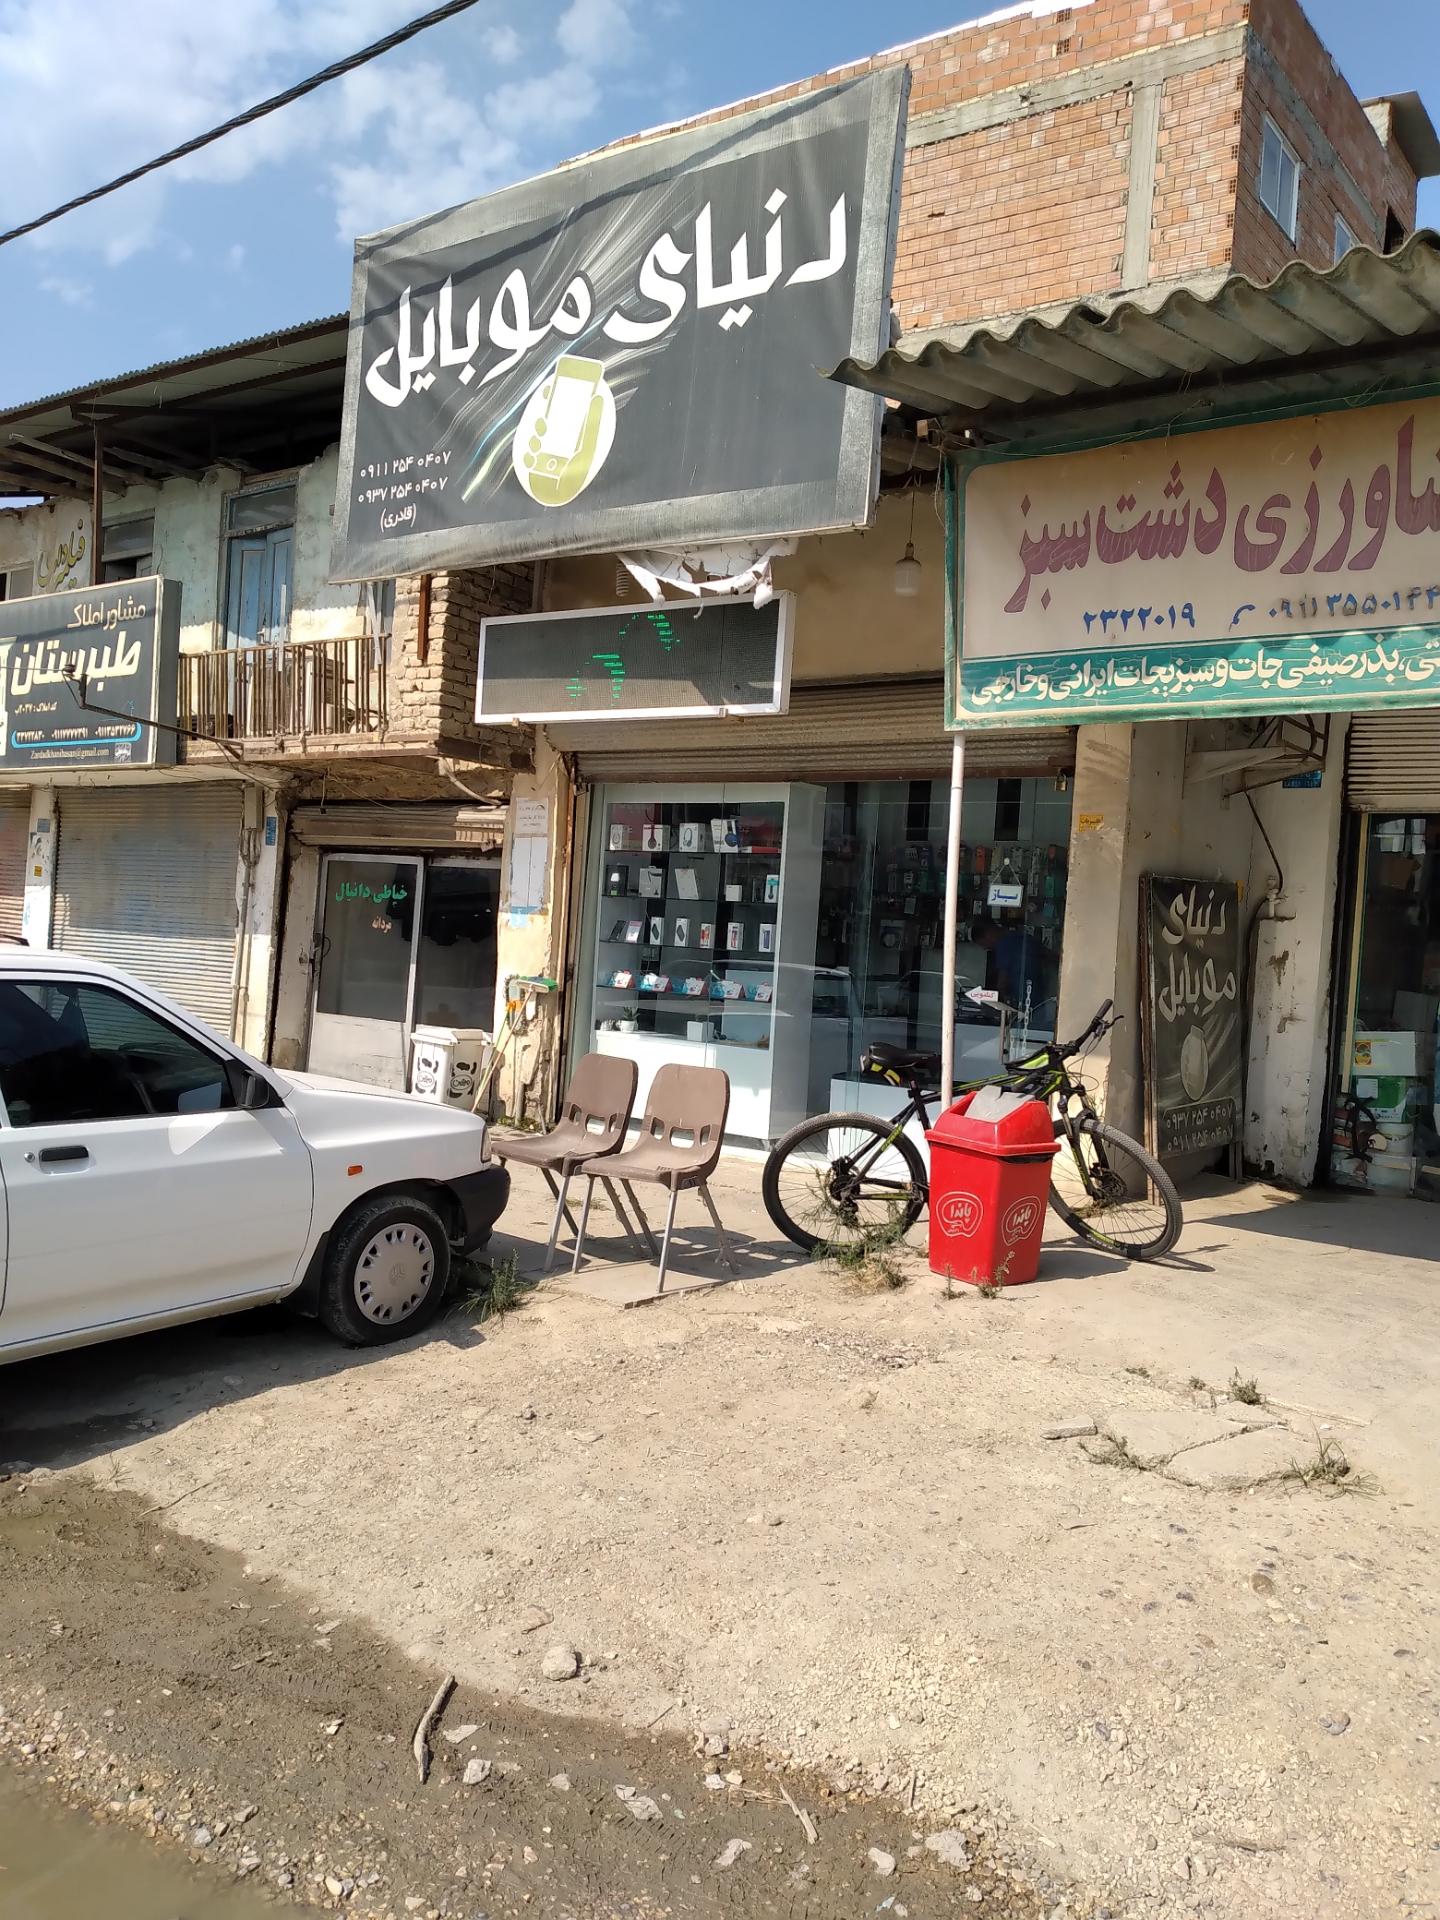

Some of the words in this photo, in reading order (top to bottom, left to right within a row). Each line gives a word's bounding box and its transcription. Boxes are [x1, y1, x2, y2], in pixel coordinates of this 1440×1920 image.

[603, 187, 847, 344] دنیای
[365, 267, 593, 408] موبایل
[1095, 460, 1227, 564] دشت
[1003, 493, 1091, 613] سبز
[66, 601, 104, 629] املاک
[103, 595, 146, 630] مشاور
[10, 630, 142, 696] طبرستان
[971, 663, 1038, 706] خارجی
[1048, 657, 1115, 700] ایرانی
[335, 882, 371, 902] دانیال
[373, 884, 408, 907] خیاطی
[372, 915, 392, 934] مردانه
[1162, 885, 1226, 948] دنیای
[1158, 952, 1237, 1022] موبایل
[950, 1202, 972, 1224] پاندا
[1012, 1205, 1033, 1227] پاندا
